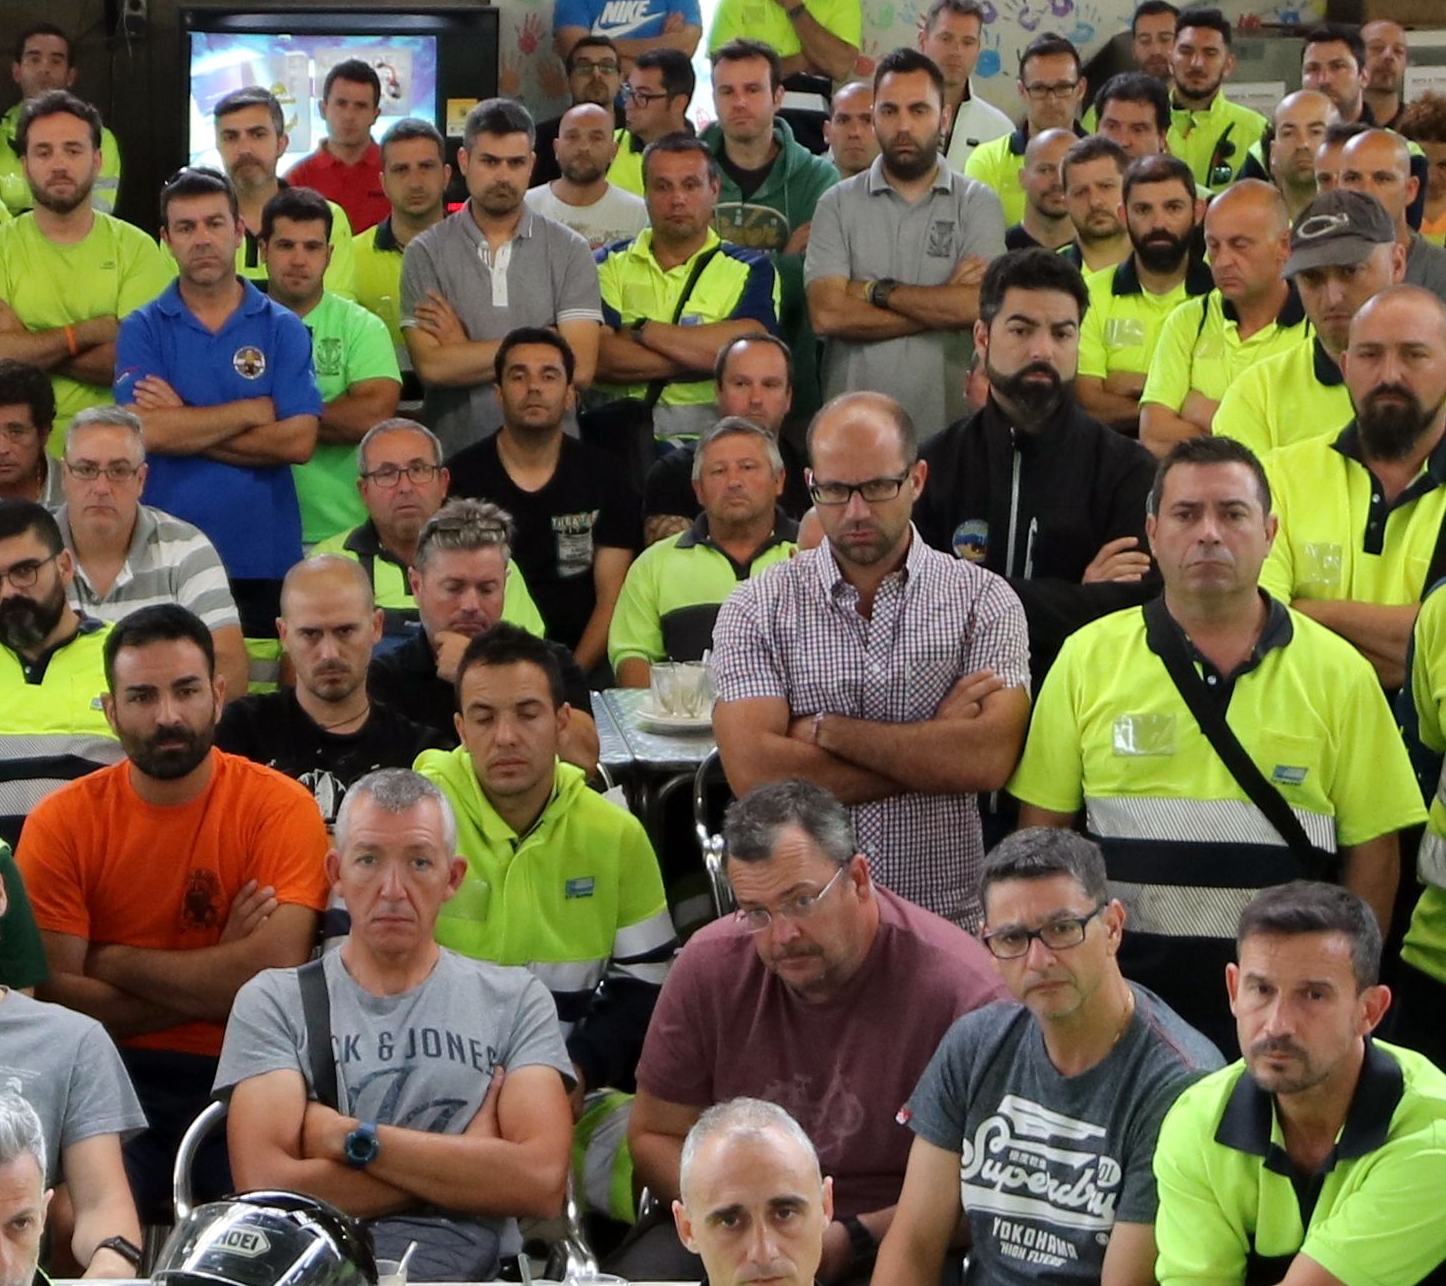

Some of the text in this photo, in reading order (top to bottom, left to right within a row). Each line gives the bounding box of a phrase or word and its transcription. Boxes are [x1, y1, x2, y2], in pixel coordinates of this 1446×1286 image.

[599, 0, 651, 25] NIKE
[378, 1031, 395, 1062] &
[961, 1114, 1117, 1223] Superdry
[214, 1229, 260, 1252] HOEI
[992, 1217, 1080, 1260] YOKOHAMA
